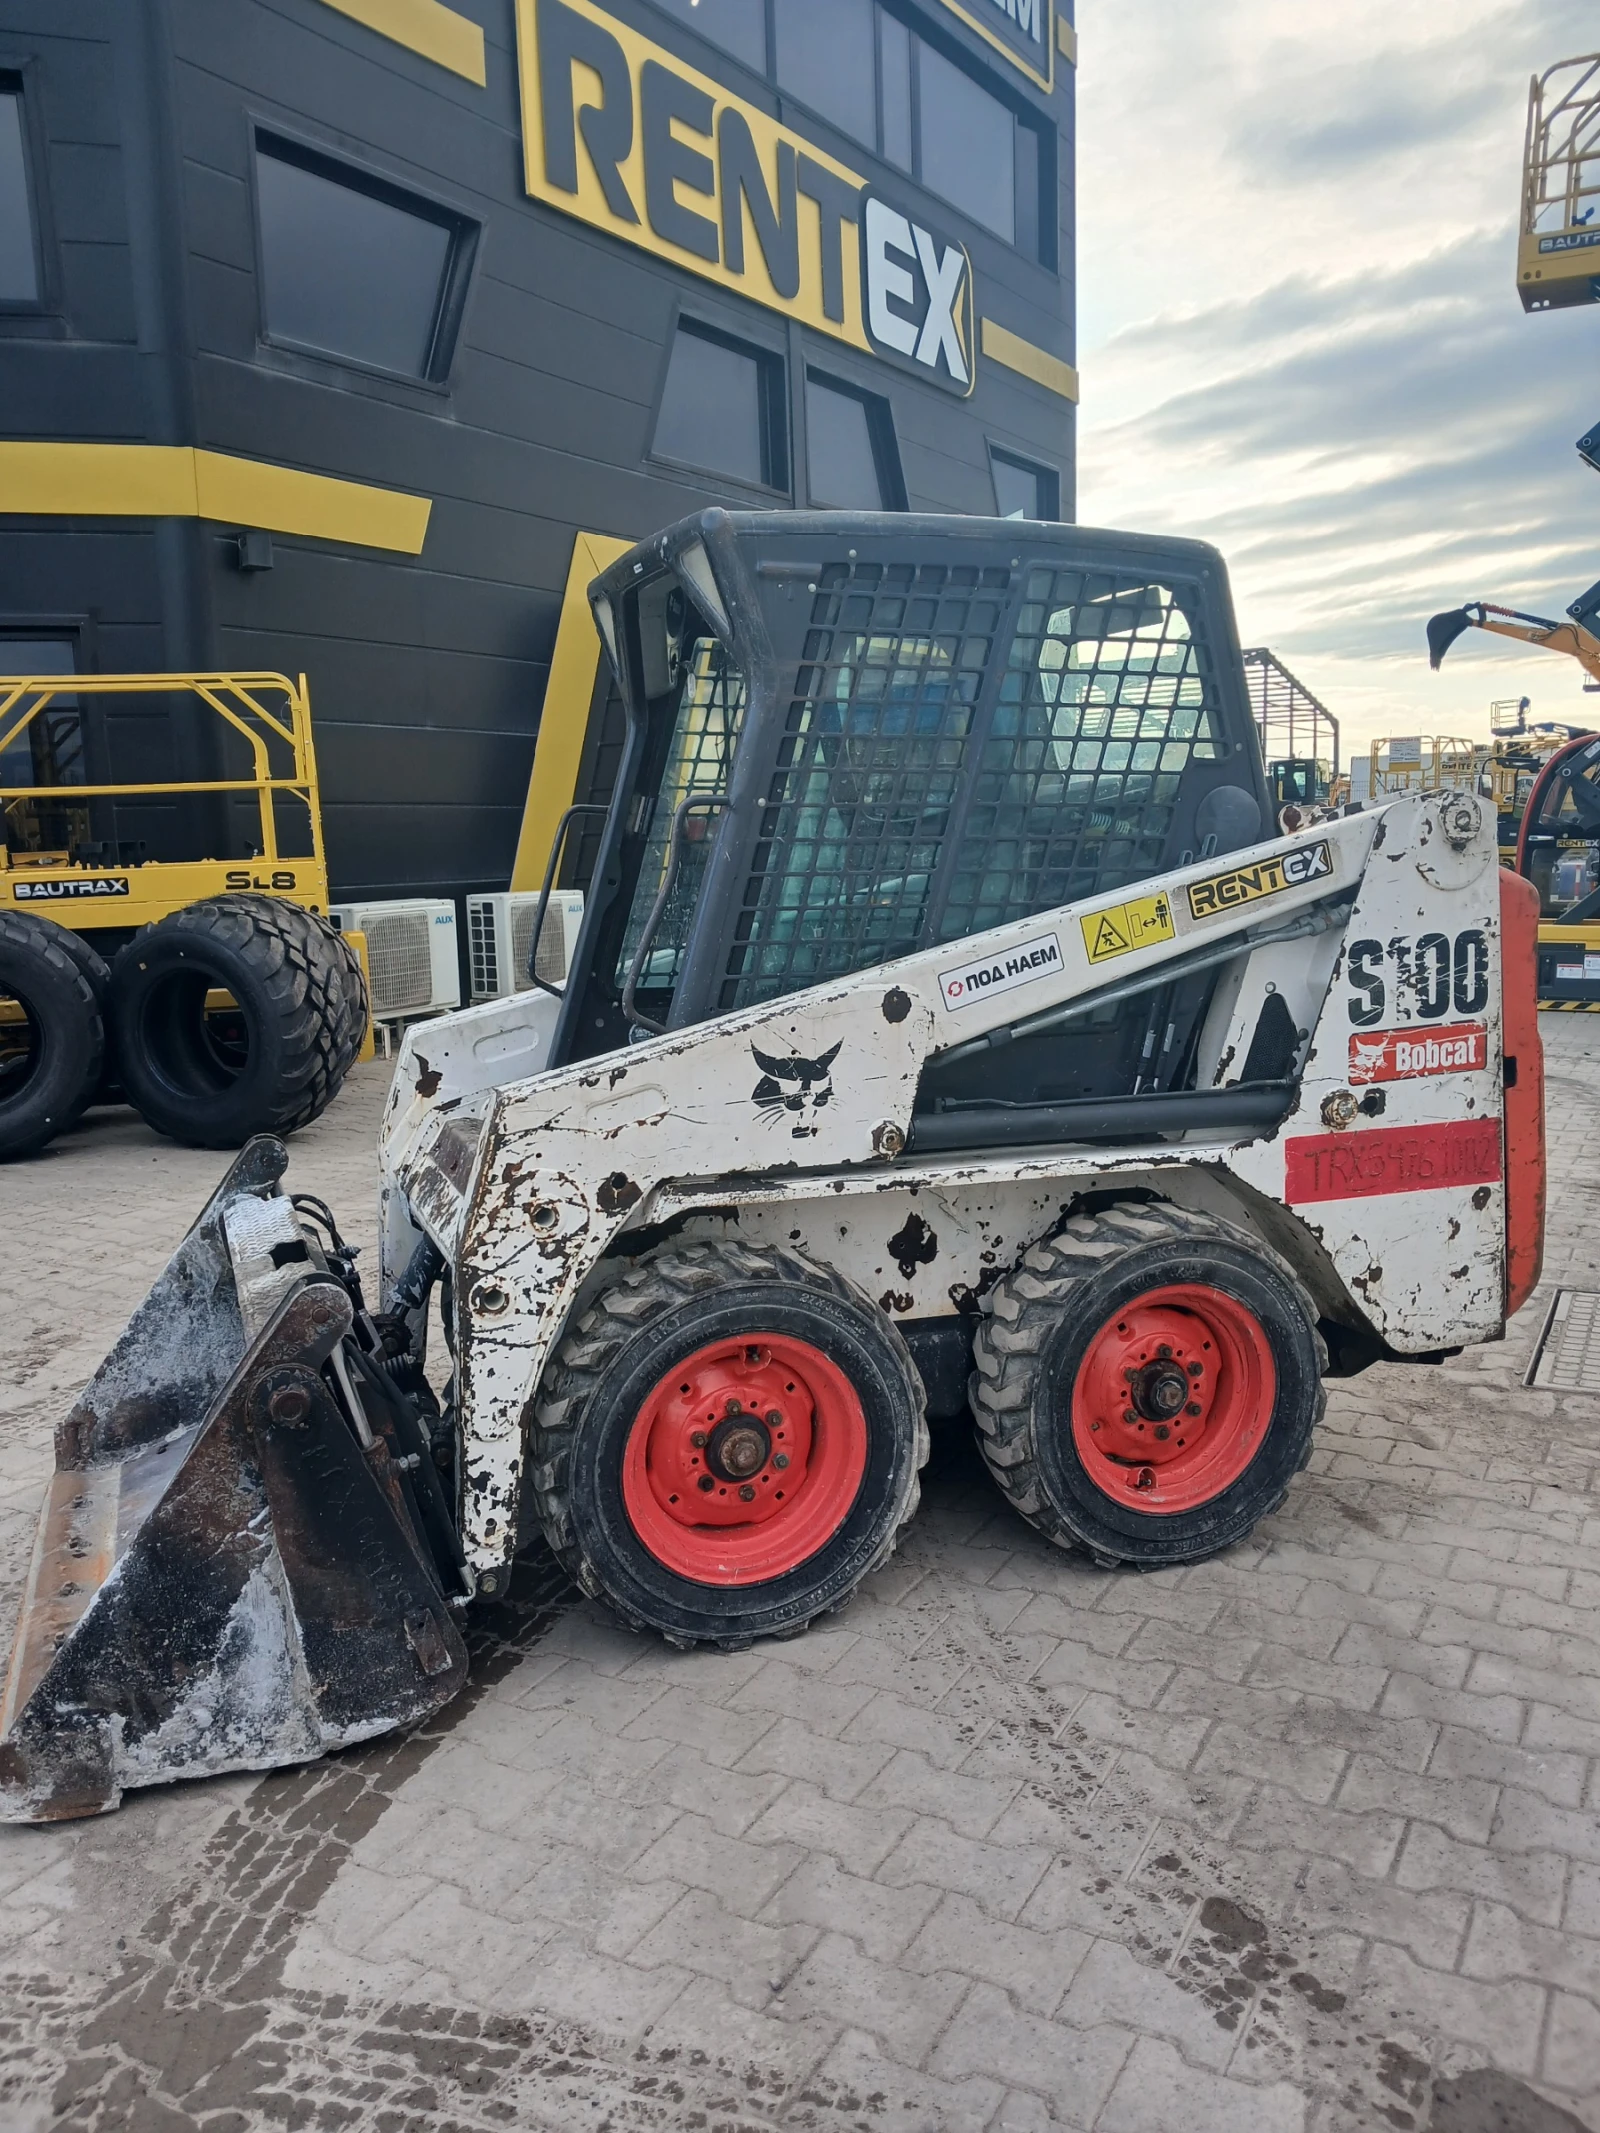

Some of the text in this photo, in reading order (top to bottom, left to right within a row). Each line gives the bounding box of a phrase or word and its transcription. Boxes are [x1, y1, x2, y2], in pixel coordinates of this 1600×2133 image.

[537, 0, 970, 385] RENTEX
[1556, 839, 1600, 848] RENTEX
[15, 878, 127, 898] BAUTRAX
[225, 871, 296, 890] SL8
[1191, 844, 1328, 915] RENTEX
[435, 915, 454, 925] AUX
[568, 904, 583, 913] AUX
[966, 945, 1058, 991] ПОД НАЕМ
[1347, 929, 1490, 1027] S100
[1395, 1035, 1477, 1072] Bobcat
